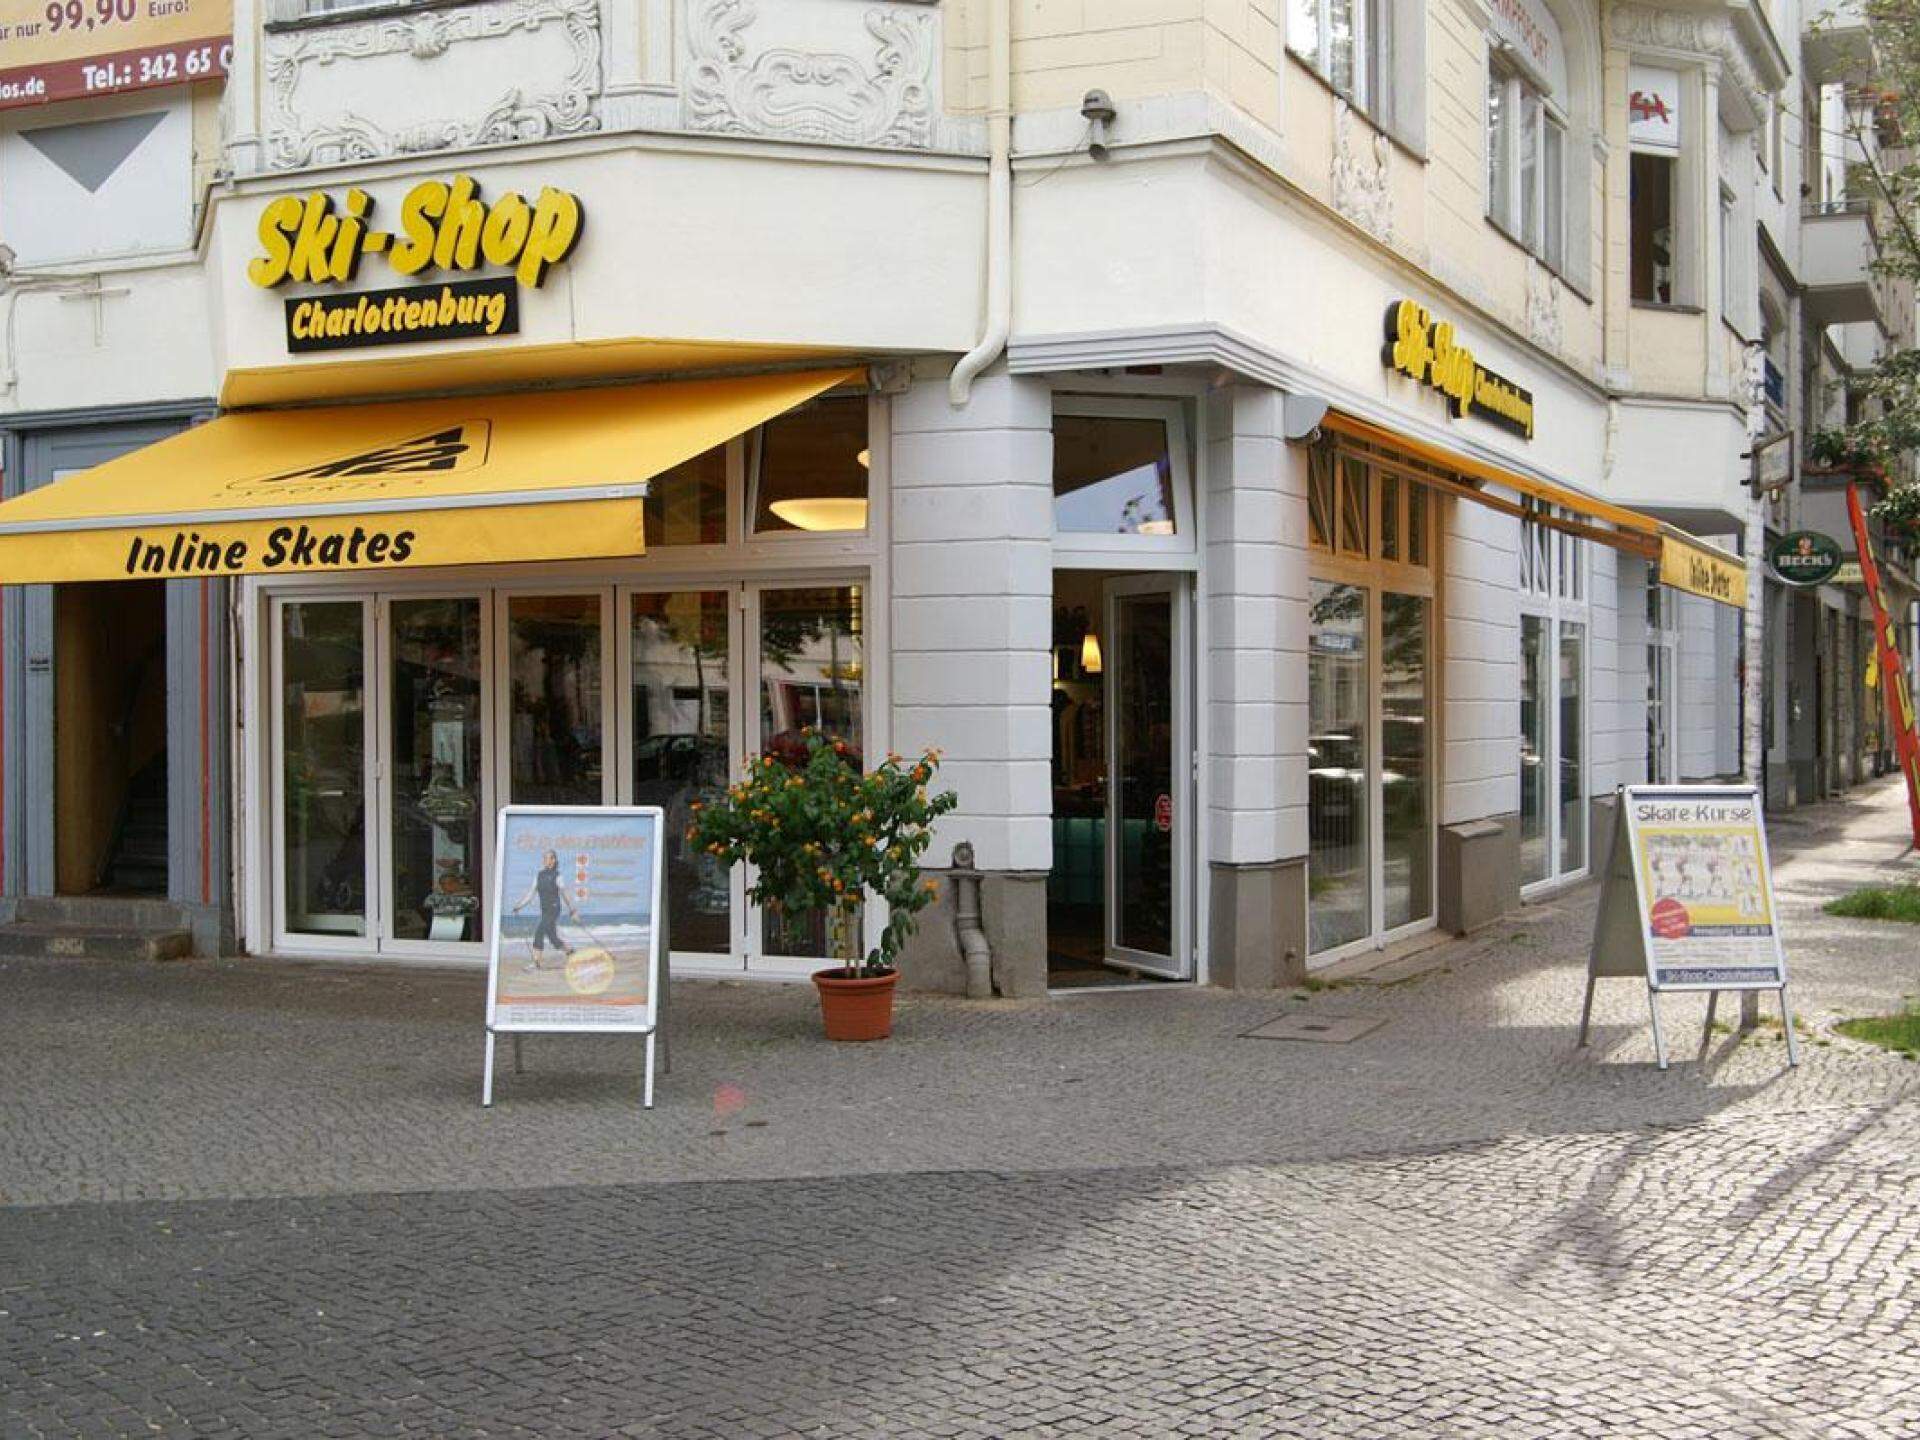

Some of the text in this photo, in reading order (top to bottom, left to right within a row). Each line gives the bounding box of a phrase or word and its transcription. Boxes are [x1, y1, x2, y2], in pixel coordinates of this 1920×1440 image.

[16, 23, 41, 38] nur
[46, 0, 136, 32] 99,90
[150, 0, 189, 17] Euro!
[82, 63, 131, 90] Tel.:
[139, 52, 178, 82] 342
[185, 47, 212, 75] 65
[248, 173, 582, 288] Ski-Shop
[292, 287, 506, 339] Charlottenburg
[126, 524, 415, 574] Inline Skates
[1638, 804, 1752, 822] Skate Kurse
